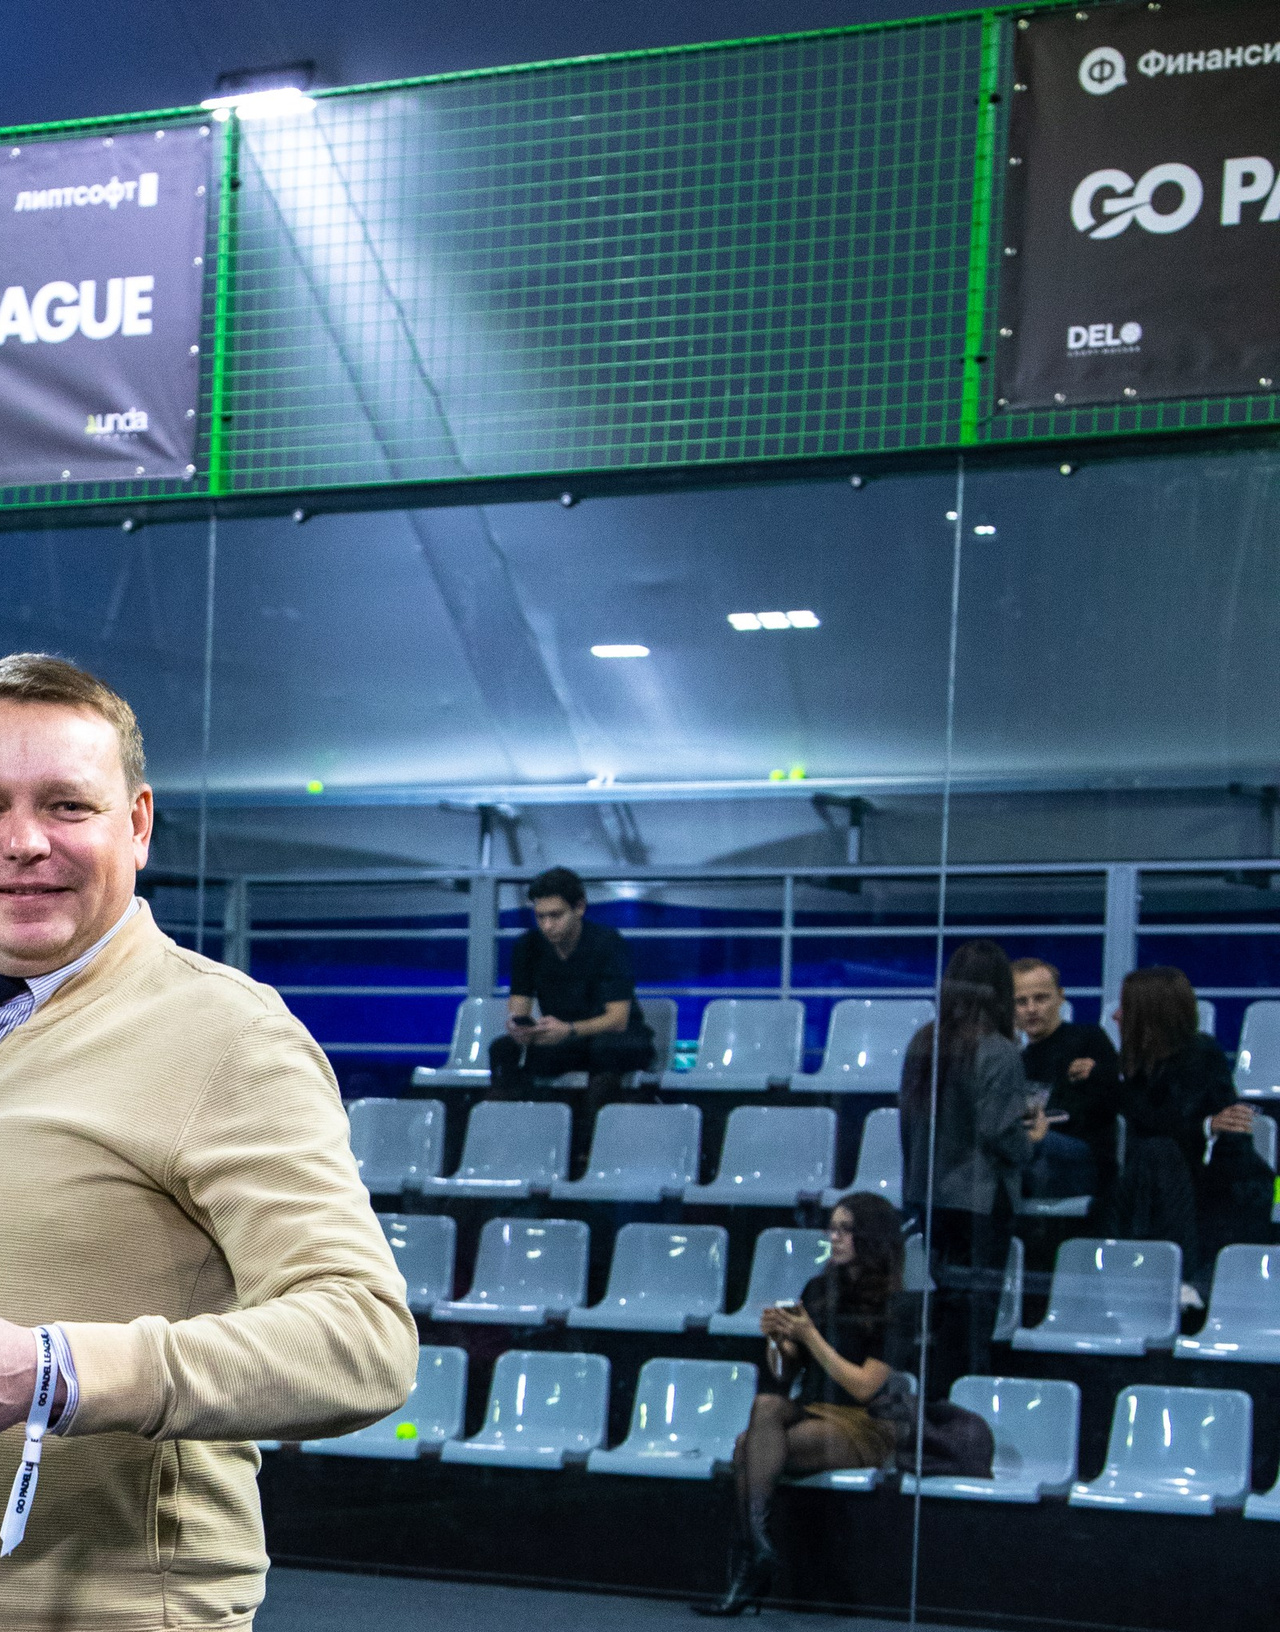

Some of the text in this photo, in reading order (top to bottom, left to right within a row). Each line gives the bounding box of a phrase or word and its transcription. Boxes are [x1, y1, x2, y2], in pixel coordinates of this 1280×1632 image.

[1071, 162, 1204, 240] GO
[38, 1333, 52, 1407] GO PADEL LEAGUE
[16, 1499, 26, 1514] GO
[19, 1473, 32, 1498] PADEL
